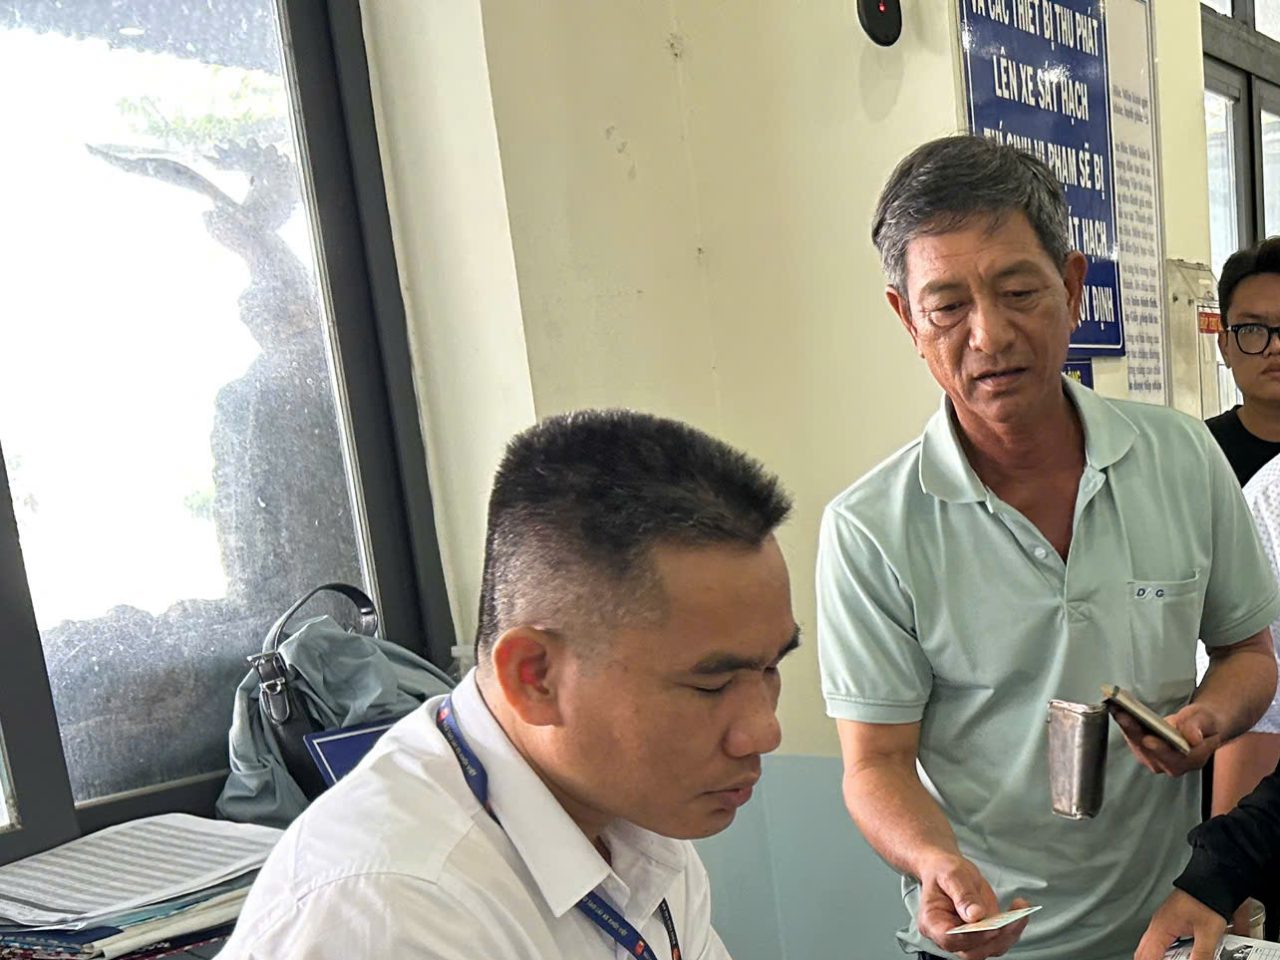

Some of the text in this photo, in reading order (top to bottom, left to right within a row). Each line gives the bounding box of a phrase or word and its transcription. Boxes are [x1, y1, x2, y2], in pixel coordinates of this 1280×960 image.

[1042, 0, 1054, 51] BỊ
[1054, 3, 1074, 48] THU
[1075, 7, 1099, 57] PHÁT
[993, 46, 1018, 101] LÊN
[1019, 63, 1036, 107] XE
[1036, 60, 1058, 112] SÁT
[1060, 78, 1089, 125] HẠCH
[1048, 143, 1078, 192] PHẠM
[1079, 142, 1092, 189] SẼ
[1093, 154, 1105, 200] BỊ
[1068, 205, 1107, 263] ÁT HẠCH
[1092, 285, 1115, 330] ĐỊNH
